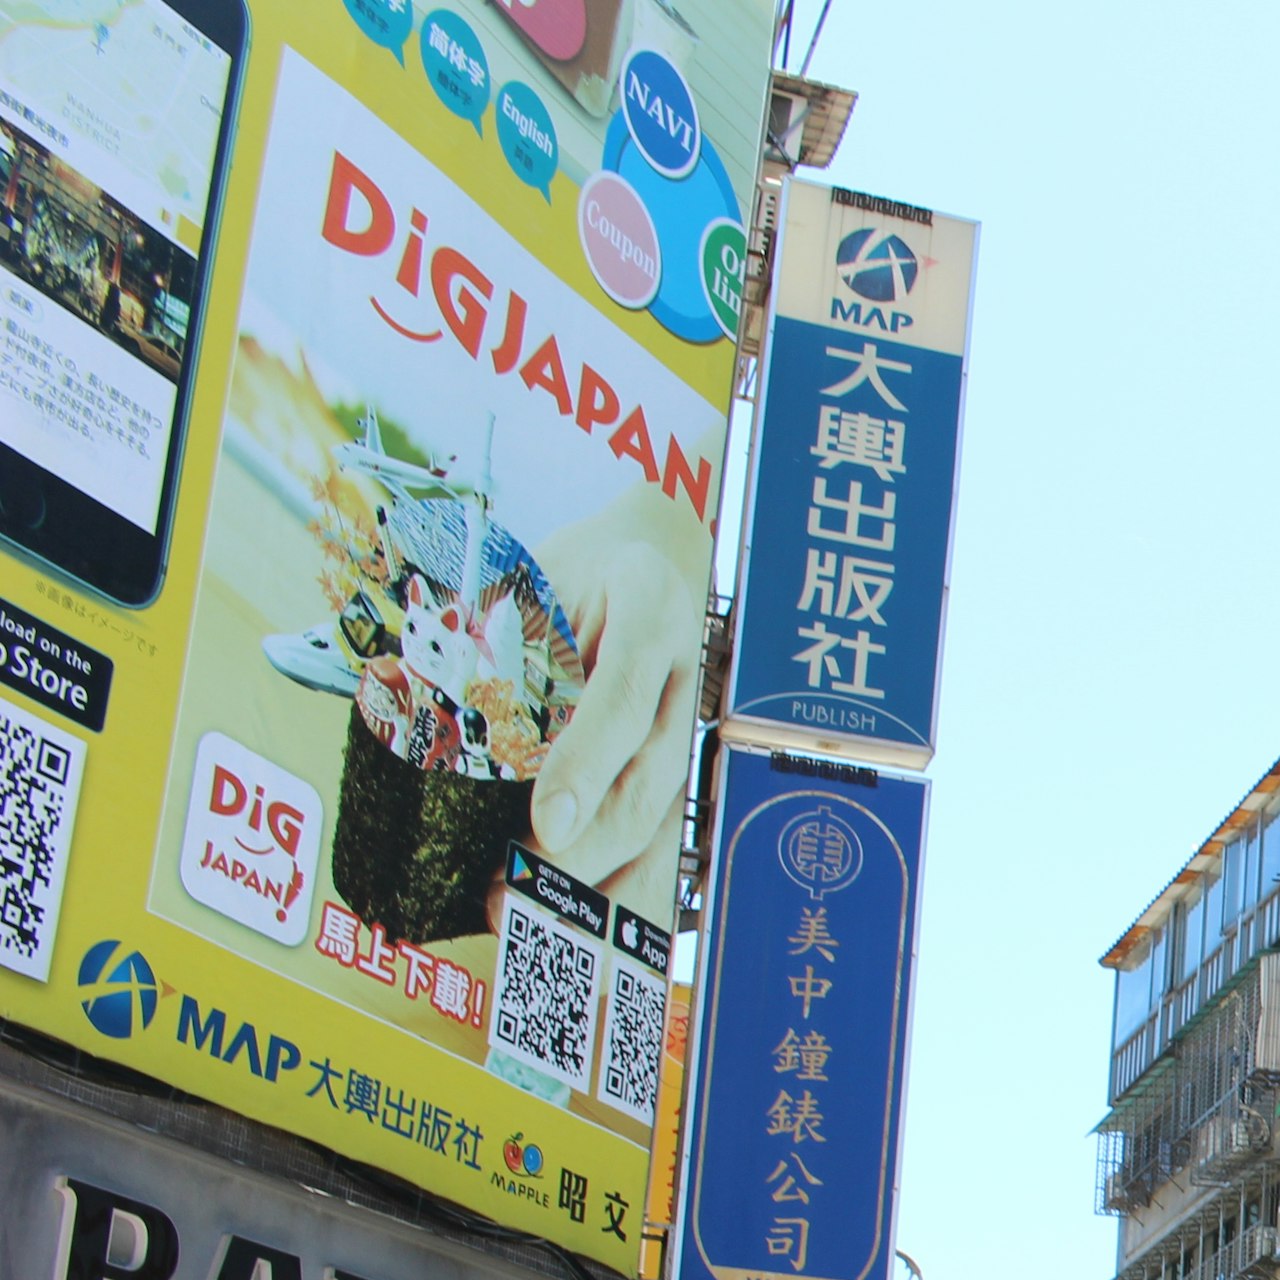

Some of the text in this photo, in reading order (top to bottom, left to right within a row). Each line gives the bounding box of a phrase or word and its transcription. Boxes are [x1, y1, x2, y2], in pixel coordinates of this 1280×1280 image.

[429, 21, 486, 89] 简体字
[501, 91, 555, 159] English
[627, 69, 694, 154] NAVI
[586, 199, 657, 279] Coupon
[830, 299, 915, 336] MAP
[10, 645, 89, 712] Store
[39, 637, 62, 659] on
[64, 649, 93, 676] the
[791, 700, 877, 734] PUBLISH
[209, 762, 306, 860] DiG
[536, 876, 603, 933] Google Play
[537, 863, 553, 880] GET
[558, 876, 572, 892] ON
[641, 939, 667, 968] App
[177, 993, 302, 1083] MAP
[765, 906, 840, 1272] 美中鐘錶公司
[490, 1173, 551, 1209] MAPPLE
